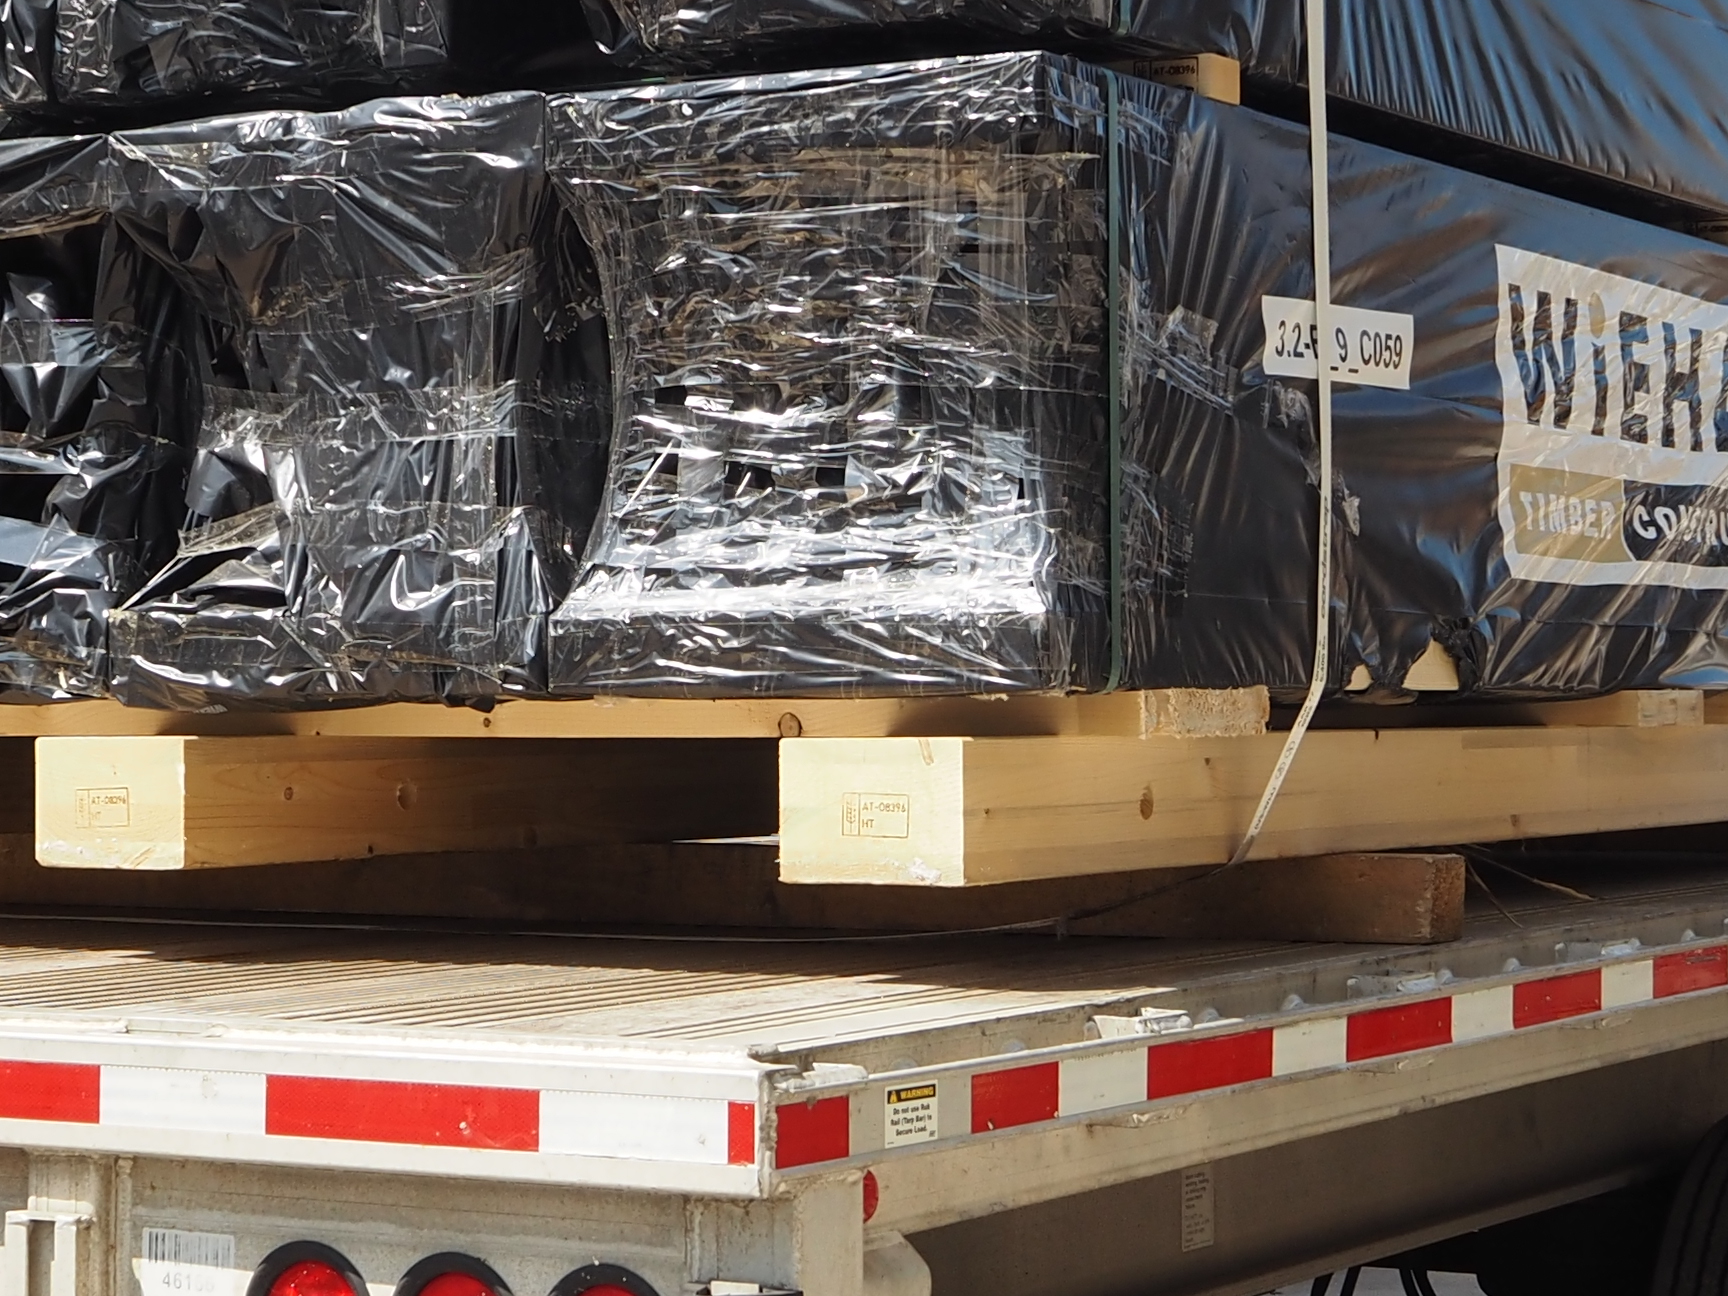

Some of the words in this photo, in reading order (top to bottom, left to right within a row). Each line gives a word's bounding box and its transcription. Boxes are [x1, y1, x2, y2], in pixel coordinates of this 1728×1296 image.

[1519, 490, 1614, 540] TIMBER
[862, 819, 874, 829] HT
[900, 1086, 934, 1100] WARNING
[896, 1128, 913, 1136] Secure
